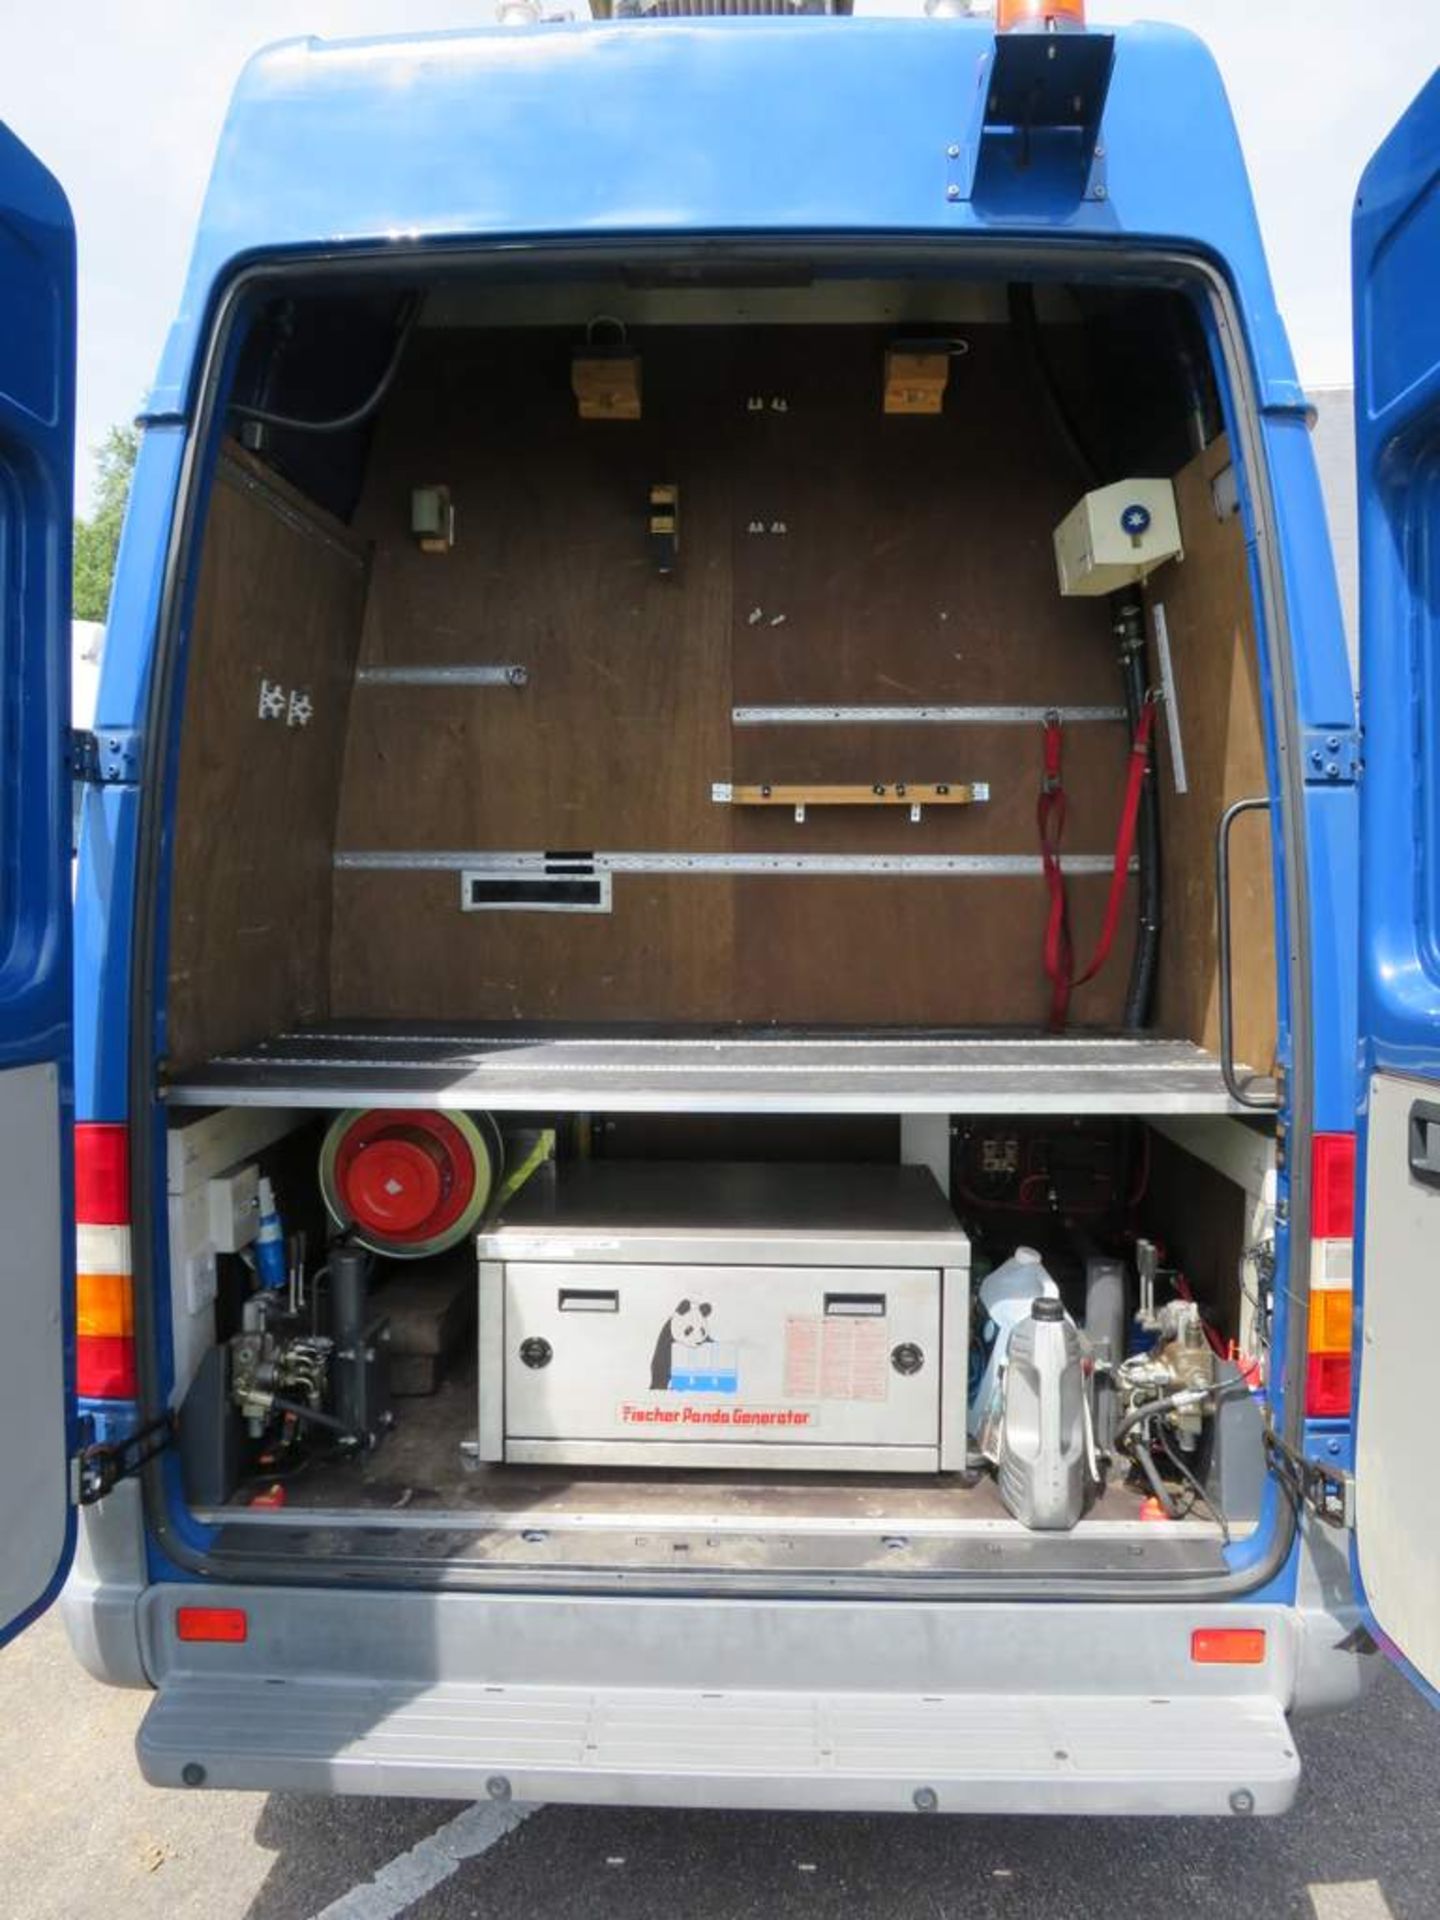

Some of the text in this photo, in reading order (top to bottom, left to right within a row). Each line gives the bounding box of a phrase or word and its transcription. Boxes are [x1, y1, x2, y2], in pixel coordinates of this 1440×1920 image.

[623, 1405, 810, 1425] Fischer Panda Generator
